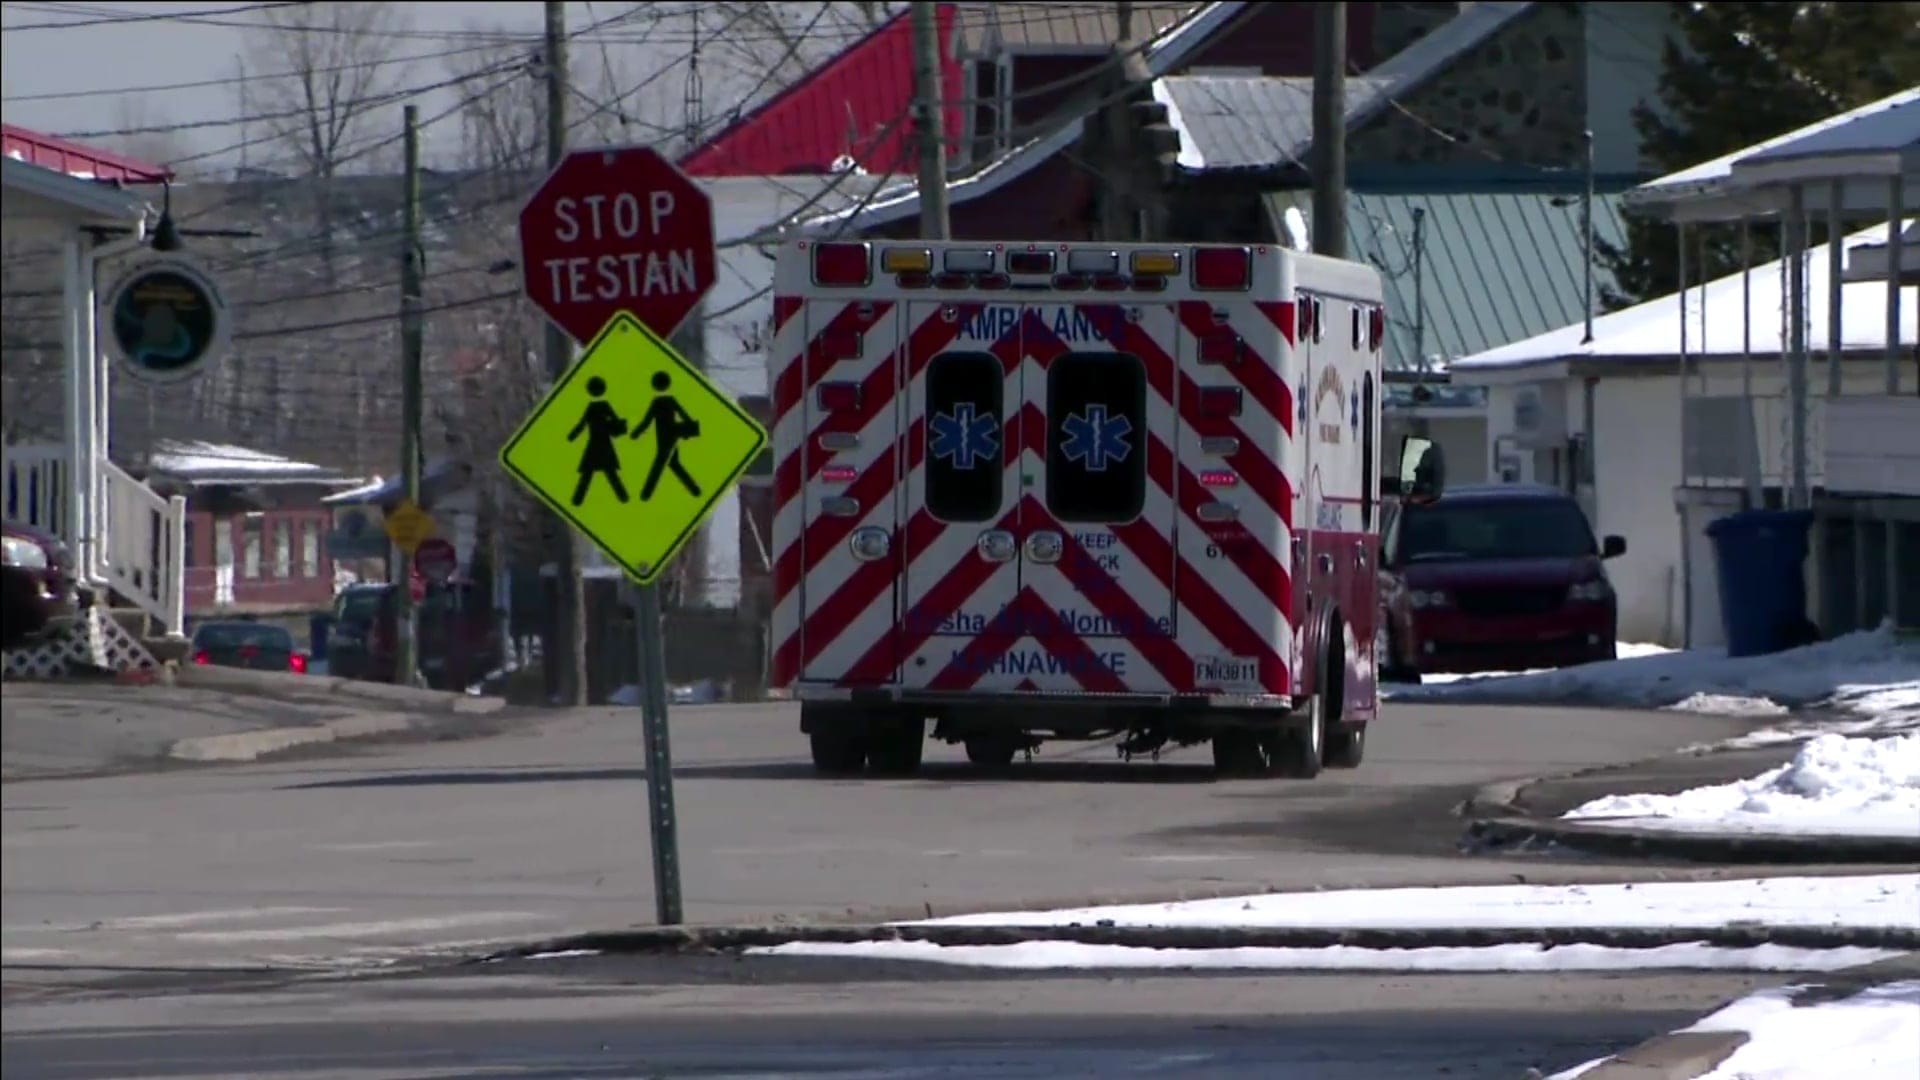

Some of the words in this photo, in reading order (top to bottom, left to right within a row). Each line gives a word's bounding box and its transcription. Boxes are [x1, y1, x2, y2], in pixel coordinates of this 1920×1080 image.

[554, 190, 675, 243] STOP
[543, 248, 697, 304] TESTAN
[956, 307, 1122, 342] AMBLANC
[1074, 533, 1117, 549] KEEP
[951, 651, 1127, 676] KHNAWKE
